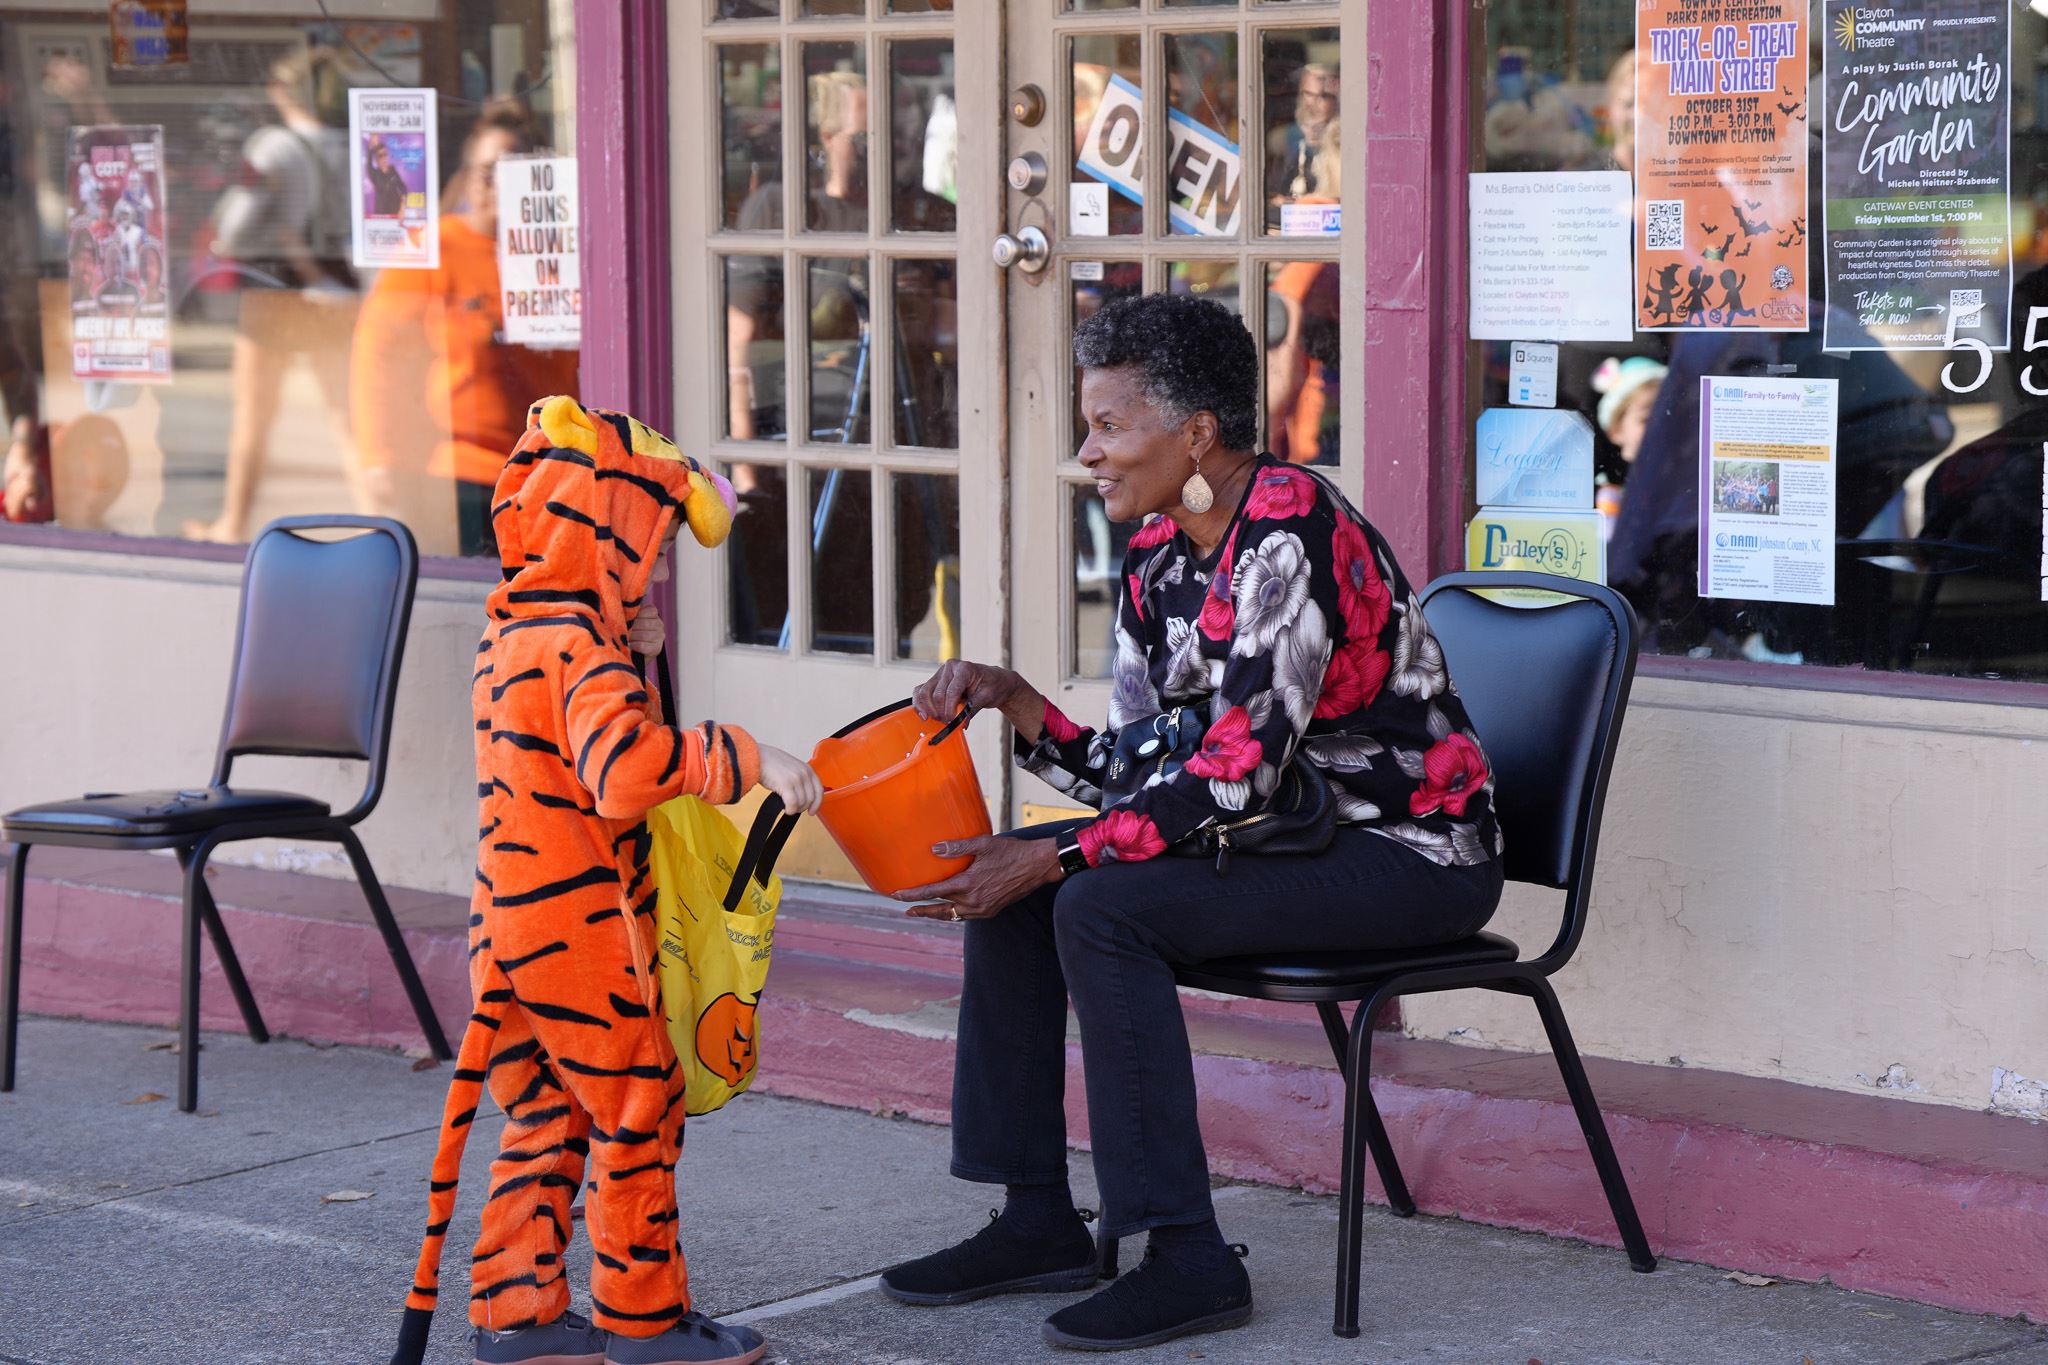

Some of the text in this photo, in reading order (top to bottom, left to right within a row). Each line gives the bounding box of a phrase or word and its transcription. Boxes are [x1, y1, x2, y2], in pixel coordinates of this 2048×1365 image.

[1667, 6, 1781, 24] PARKS AND RECREATION
[1856, 7, 1894, 22] Clayton
[1933, 16, 1997, 27] PROUDLY PRESENTS
[1856, 18, 1926, 34] COMMUNITY
[1856, 36, 1895, 49] Theatre
[1842, 59, 1959, 76] A play by Justin Borak
[1670, 58, 1777, 94] MAIN STREET
[1835, 52, 2001, 133] Community
[1686, 97, 1759, 114] OCTOBER 31ST
[1669, 115, 1690, 130] 1:00
[1728, 114, 1750, 128] 3:00
[1668, 127, 1775, 145] DOWNTOWN CLAYTON
[1858, 111, 1975, 182] Garden
[1777, 155, 1792, 163] your
[1099, 104, 1240, 232] OEN
[1677, 168, 1689, 176] and
[1769, 166, 1795, 174] business
[1919, 168, 1968, 178] Directed by
[531, 164, 554, 192] NO
[1888, 177, 2000, 188] Michele Heitner-Brabender
[1534, 184, 1554, 193] Child
[1556, 184, 1576, 193] Care
[1578, 183, 1611, 193] Services
[521, 196, 569, 223] GUNS
[1864, 200, 1974, 212] GATEWAY EVENT CENTER
[1855, 212, 1982, 226] Friday November 1st, 7:00 PM
[508, 227, 576, 255] ALLOWE
[1834, 239, 1877, 250] Community
[1878, 239, 1904, 248] Garden
[1913, 239, 1922, 247] an
[1923, 238, 1950, 248] original
[1952, 238, 1966, 248] play
[1968, 237, 1989, 245] about
[1839, 250, 1864, 259] impact
[1866, 249, 1873, 258] of
[1874, 249, 1915, 259] community
[1917, 248, 1931, 256] told
[1932, 248, 1962, 257] through
[1969, 247, 1989, 255] series
[1991, 246, 1999, 255] of
[536, 258, 560, 286] ON
[1848, 258, 1990, 270] heartfelt vignettes. Don't miss the debut
[1838, 269, 2000, 281] production from Clayton Community Theatre!
[507, 289, 581, 317] PREMISE
[1853, 290, 1913, 310] Tickets on
[1859, 311, 1911, 326] sale now
[1527, 352, 1553, 364] Square
[1724, 387, 1743, 399] NAMI
[1743, 390, 1801, 402] Family-to-Family
[1486, 433, 1563, 472] Legacy
[1482, 524, 1565, 567] Dudley's
[1730, 534, 1758, 548] NAMI
[1759, 535, 1786, 551] Johnston
[1811, 538, 1822, 553] NC
